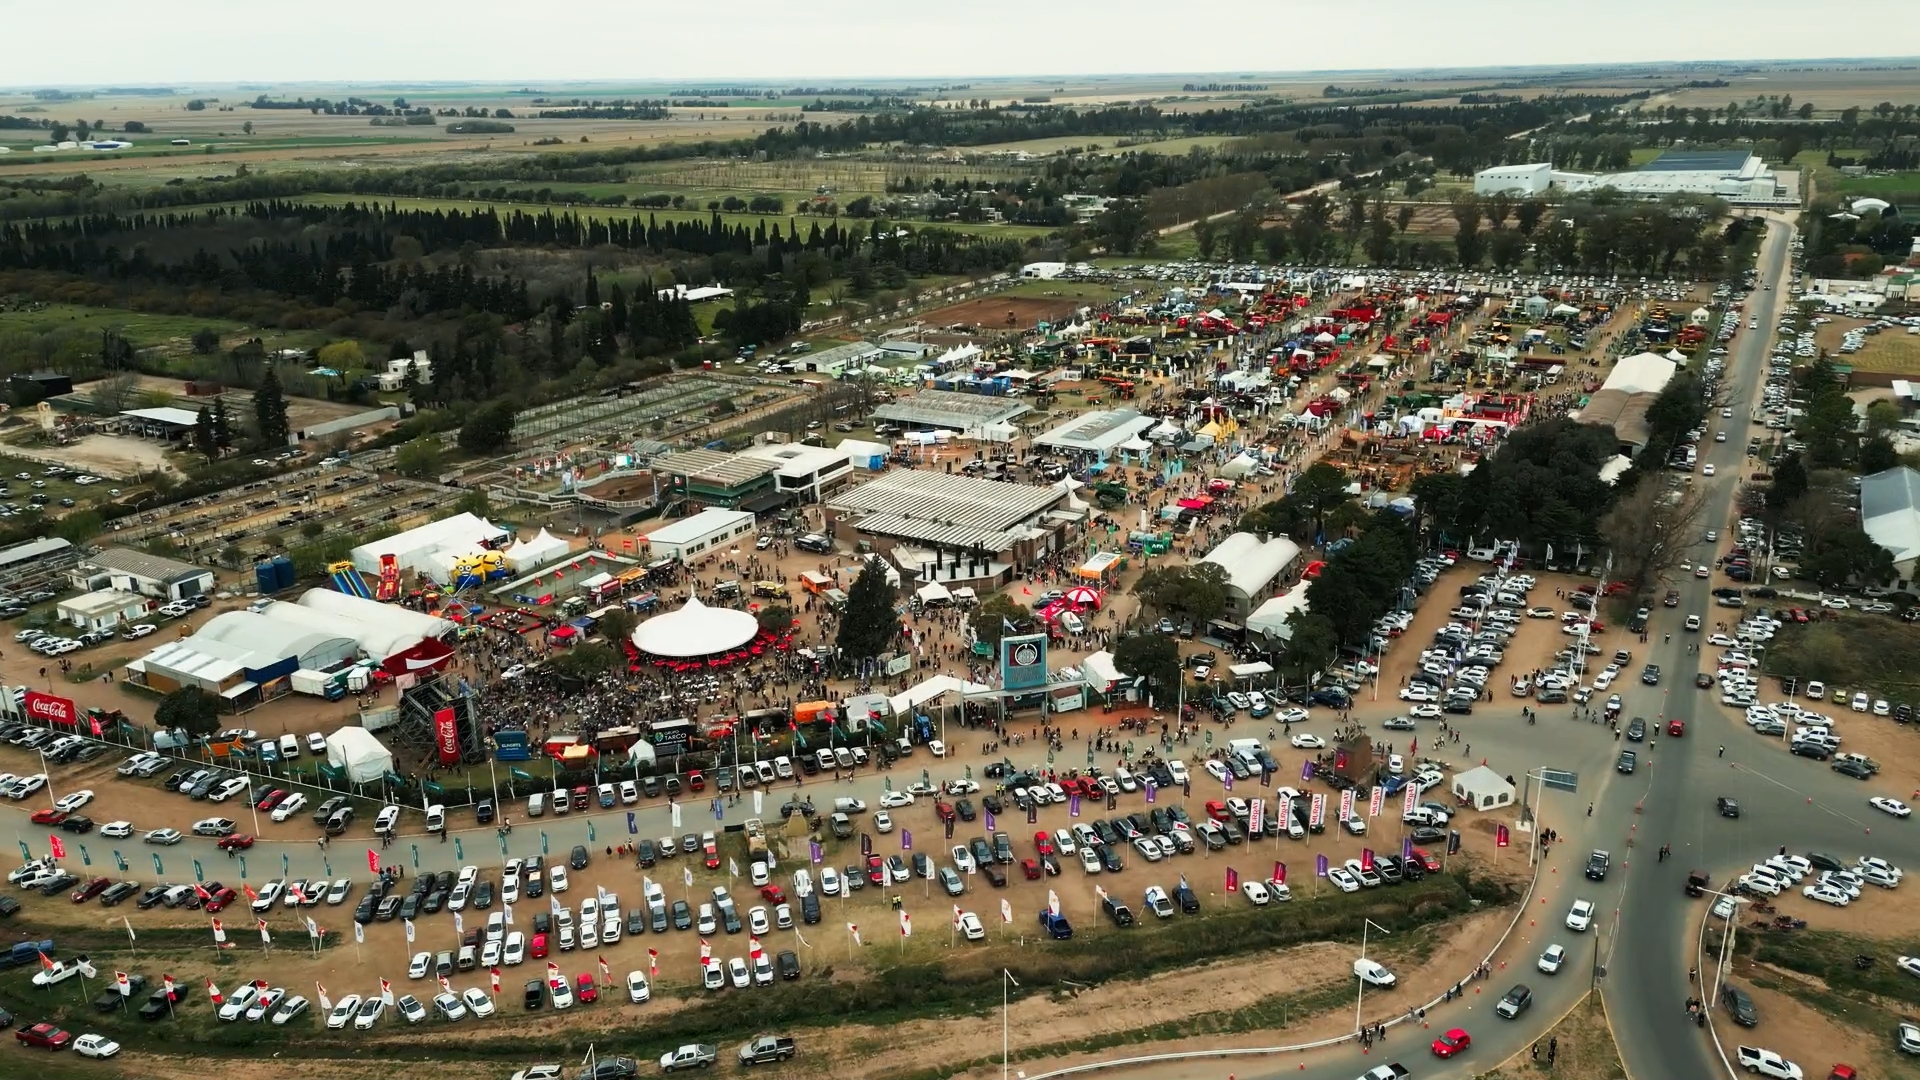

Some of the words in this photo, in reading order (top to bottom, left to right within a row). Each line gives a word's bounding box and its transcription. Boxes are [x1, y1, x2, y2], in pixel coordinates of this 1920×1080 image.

[664, 732, 687, 741] TARCO
[1251, 802, 1259, 831] MURRAY
[1279, 801, 1288, 828] MURRAY
[1311, 796, 1321, 824] MURRAY
[1341, 791, 1350, 819] MURRAY
